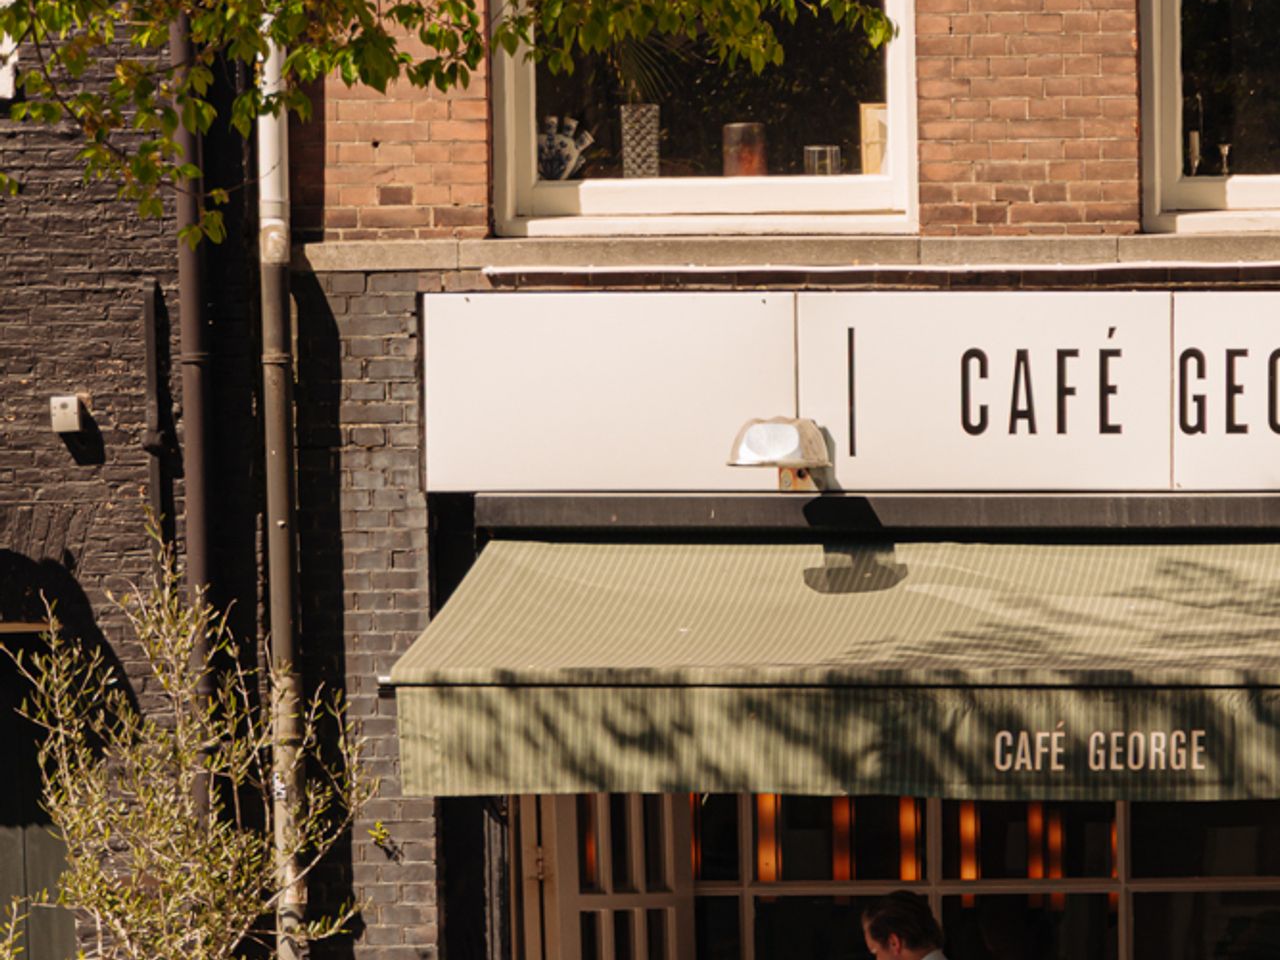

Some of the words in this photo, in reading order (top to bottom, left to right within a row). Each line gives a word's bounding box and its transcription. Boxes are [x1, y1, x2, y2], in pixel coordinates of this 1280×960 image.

[960, 326, 1123, 436] CAFÉ
[994, 720, 1066, 772] CAFÉ
[1088, 729, 1206, 772] GEORGE
